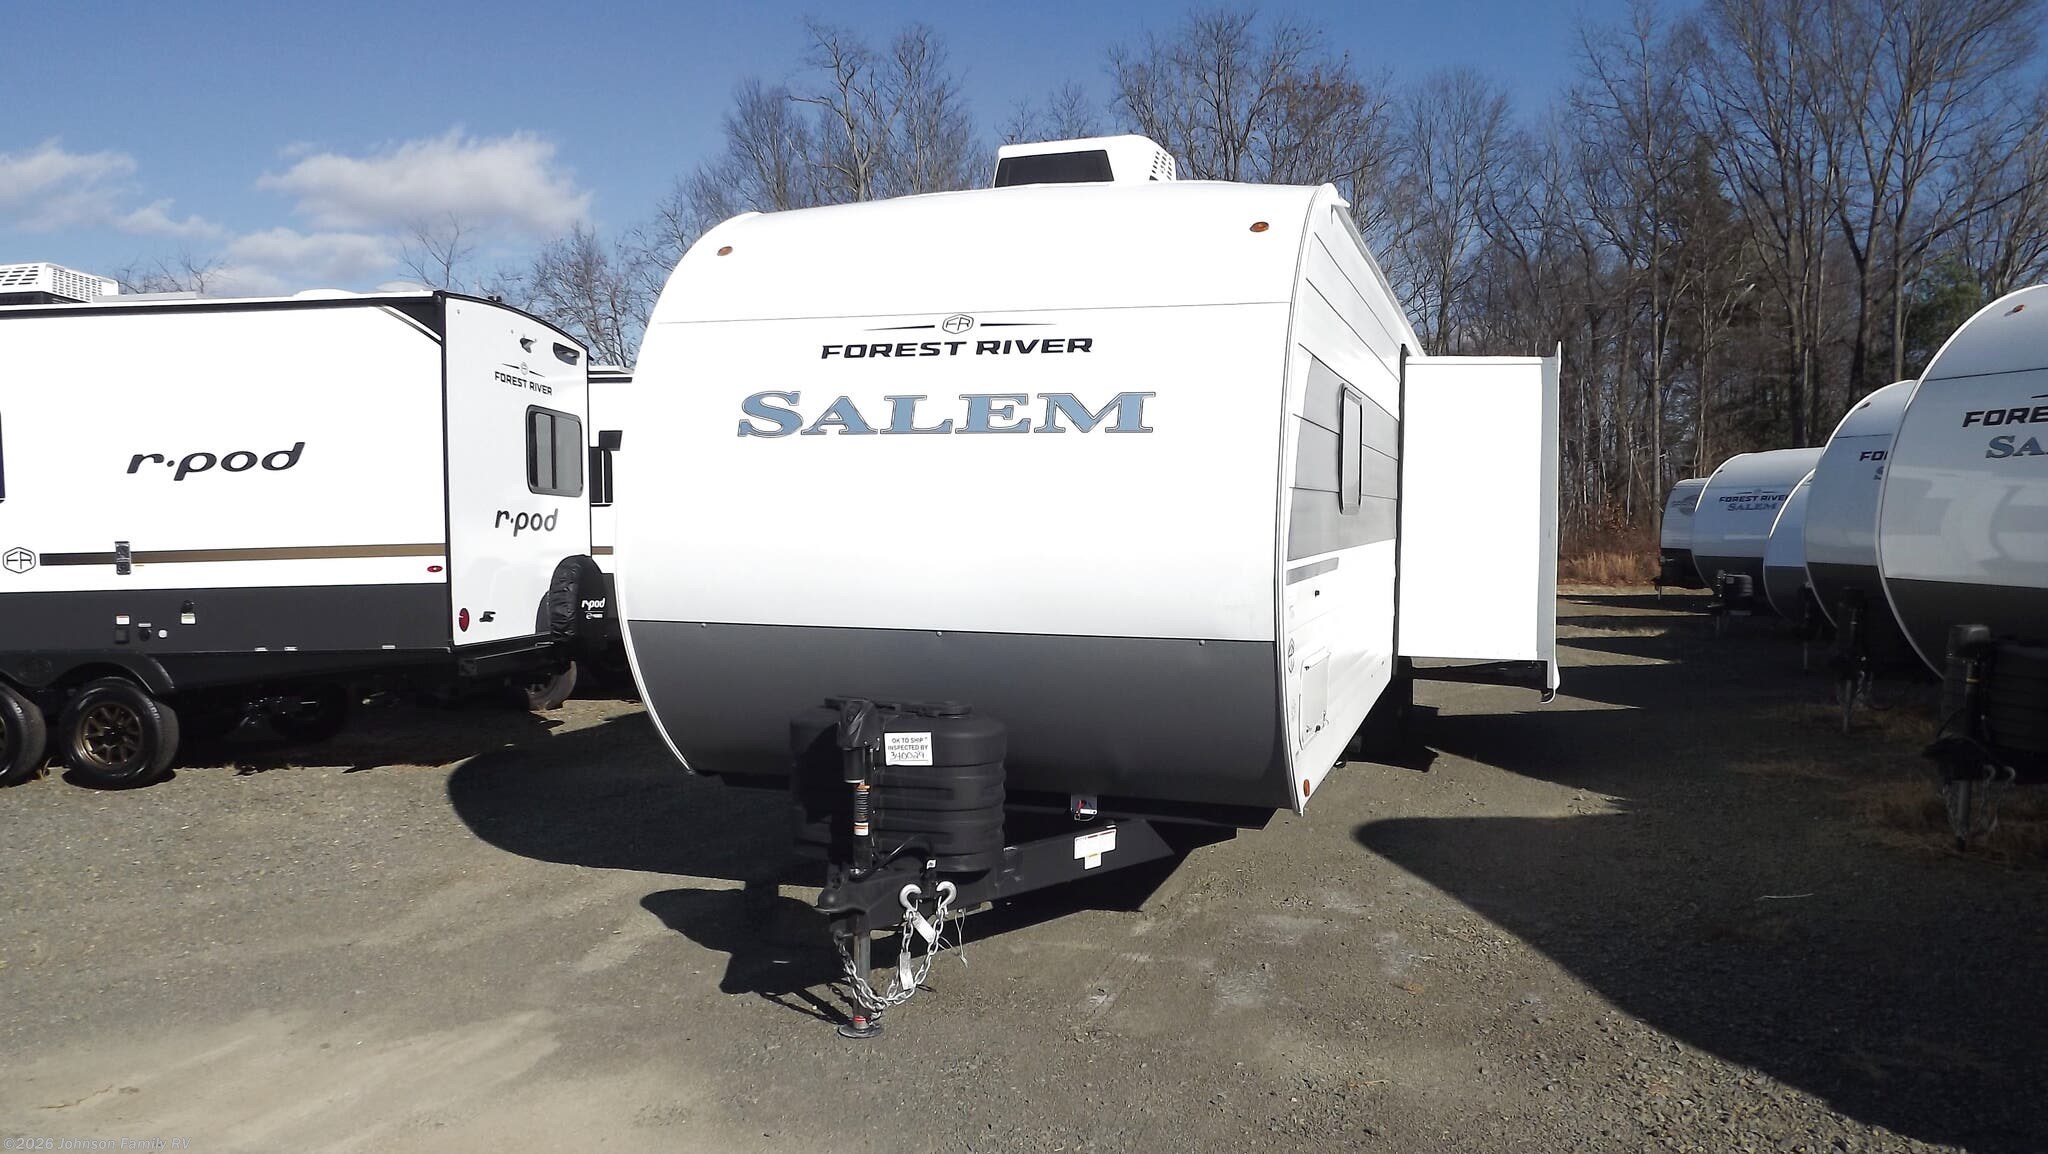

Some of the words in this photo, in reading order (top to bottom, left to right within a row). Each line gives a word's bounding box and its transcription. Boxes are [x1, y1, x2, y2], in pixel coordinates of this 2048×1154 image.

[821, 341, 967, 359] FOREST
[975, 338, 1093, 355] RIVER
[494, 371, 527, 388] FOREST
[529, 381, 553, 396] RIVER
[737, 390, 1157, 438] SALEM
[1985, 435, 2048, 458] SA
[1719, 495, 1759, 503] FOREST
[1727, 502, 1777, 512] SALEM
